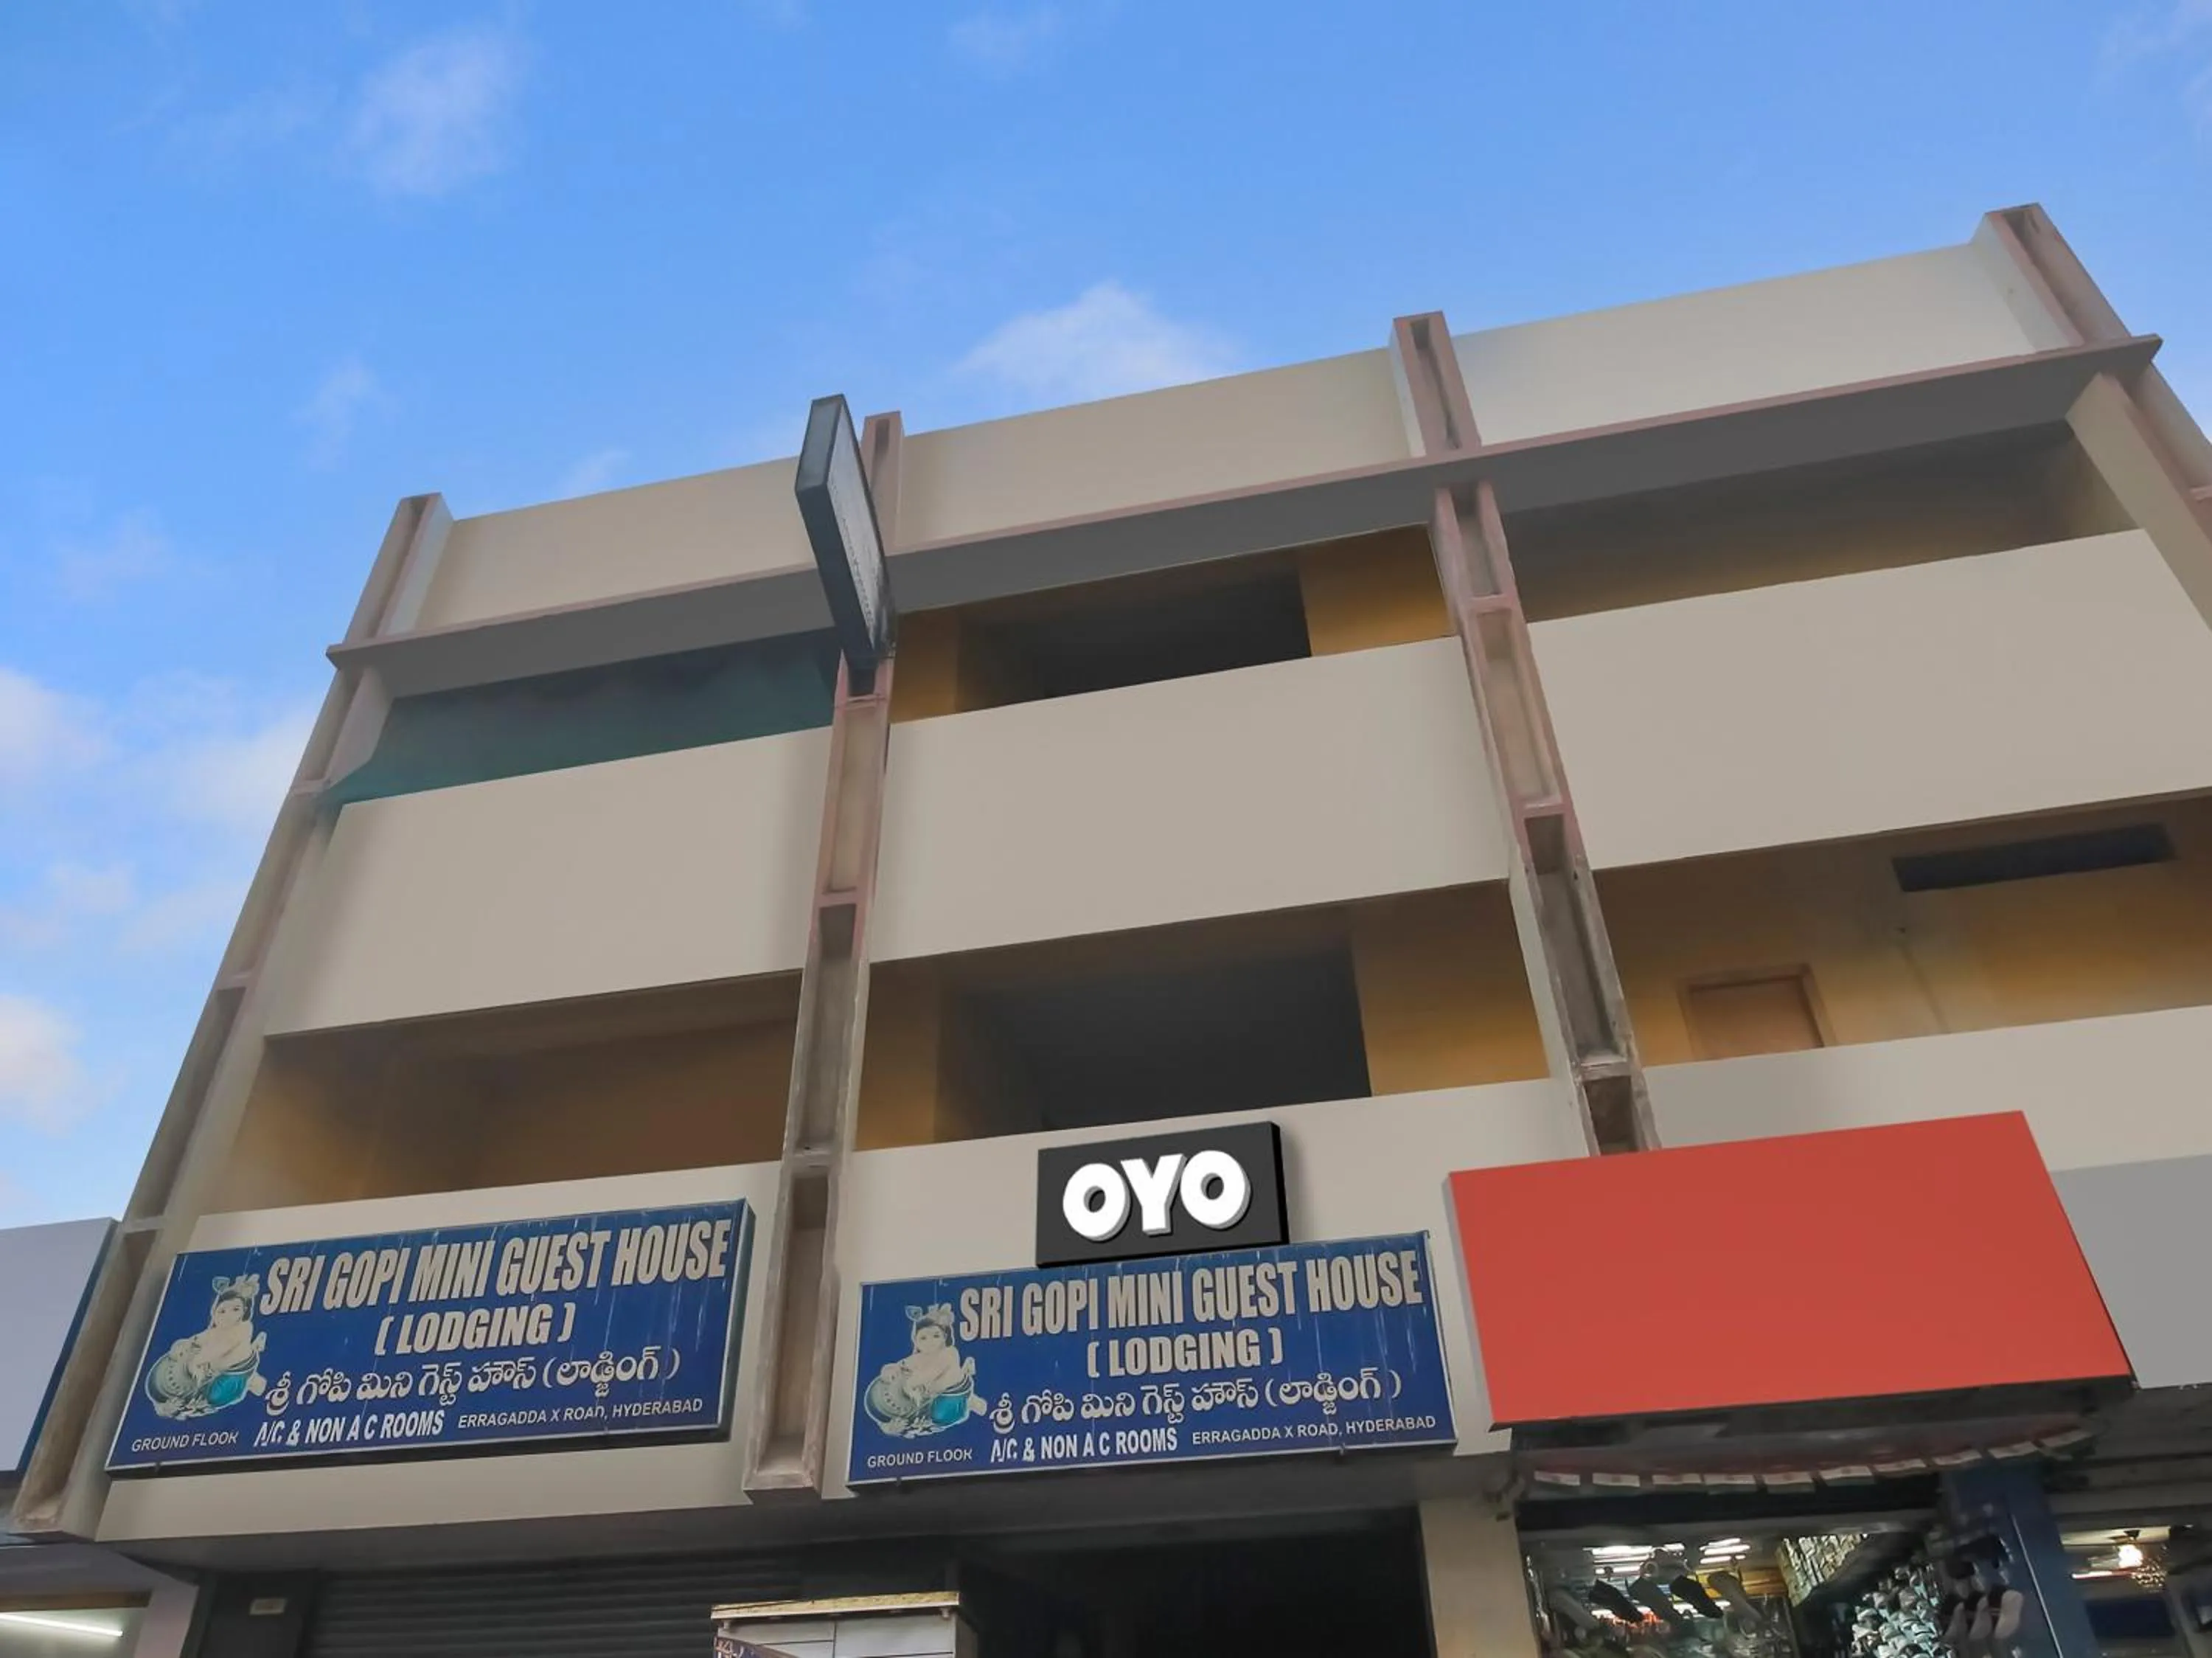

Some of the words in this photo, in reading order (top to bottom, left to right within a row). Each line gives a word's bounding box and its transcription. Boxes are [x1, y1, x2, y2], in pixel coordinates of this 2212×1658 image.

[1062, 1149, 1251, 1242] OYO
[260, 1255, 325, 1316] SRI
[323, 1247, 411, 1311] GOPI
[407, 1240, 495, 1303] MINI
[495, 1229, 611, 1297] GUEST
[611, 1218, 732, 1286] HOUSE
[960, 1286, 1013, 1342] SRI
[1022, 1278, 1099, 1336] GOPI
[1107, 1271, 1183, 1328] MINI
[1192, 1260, 1298, 1322] GUEST
[1306, 1250, 1424, 1313] HOUSE
[265, 1370, 291, 1416] శ్రీ
[296, 1367, 352, 1405] గోపి
[356, 1370, 414, 1401] మిని
[418, 1361, 462, 1406] గెస్ట్
[467, 1356, 536, 1393] హౌస్
[458, 1410, 547, 1429] ERRAGADDA
[549, 1409, 560, 1422] X
[612, 1398, 703, 1418] HYDERABAD
[989, 1392, 1015, 1435] శ్రీ
[1021, 1389, 1074, 1424] గోపి
[1080, 1392, 1135, 1420] మిని
[1140, 1383, 1185, 1424] గెస్ట్
[1191, 1377, 1259, 1411] హౌస్
[131, 1433, 189, 1452] GROUND
[285, 1419, 302, 1446] &
[305, 1415, 346, 1444] NON
[380, 1409, 445, 1439] ROOMS
[1023, 1437, 1035, 1462] &
[1041, 1434, 1077, 1460] NON
[1116, 1427, 1178, 1456] ROOMS
[1192, 1426, 1281, 1446] ERRAGADDA
[1283, 1426, 1294, 1439] X
[1346, 1415, 1436, 1435] HYDERABAD
[867, 1451, 924, 1468] GROUND
